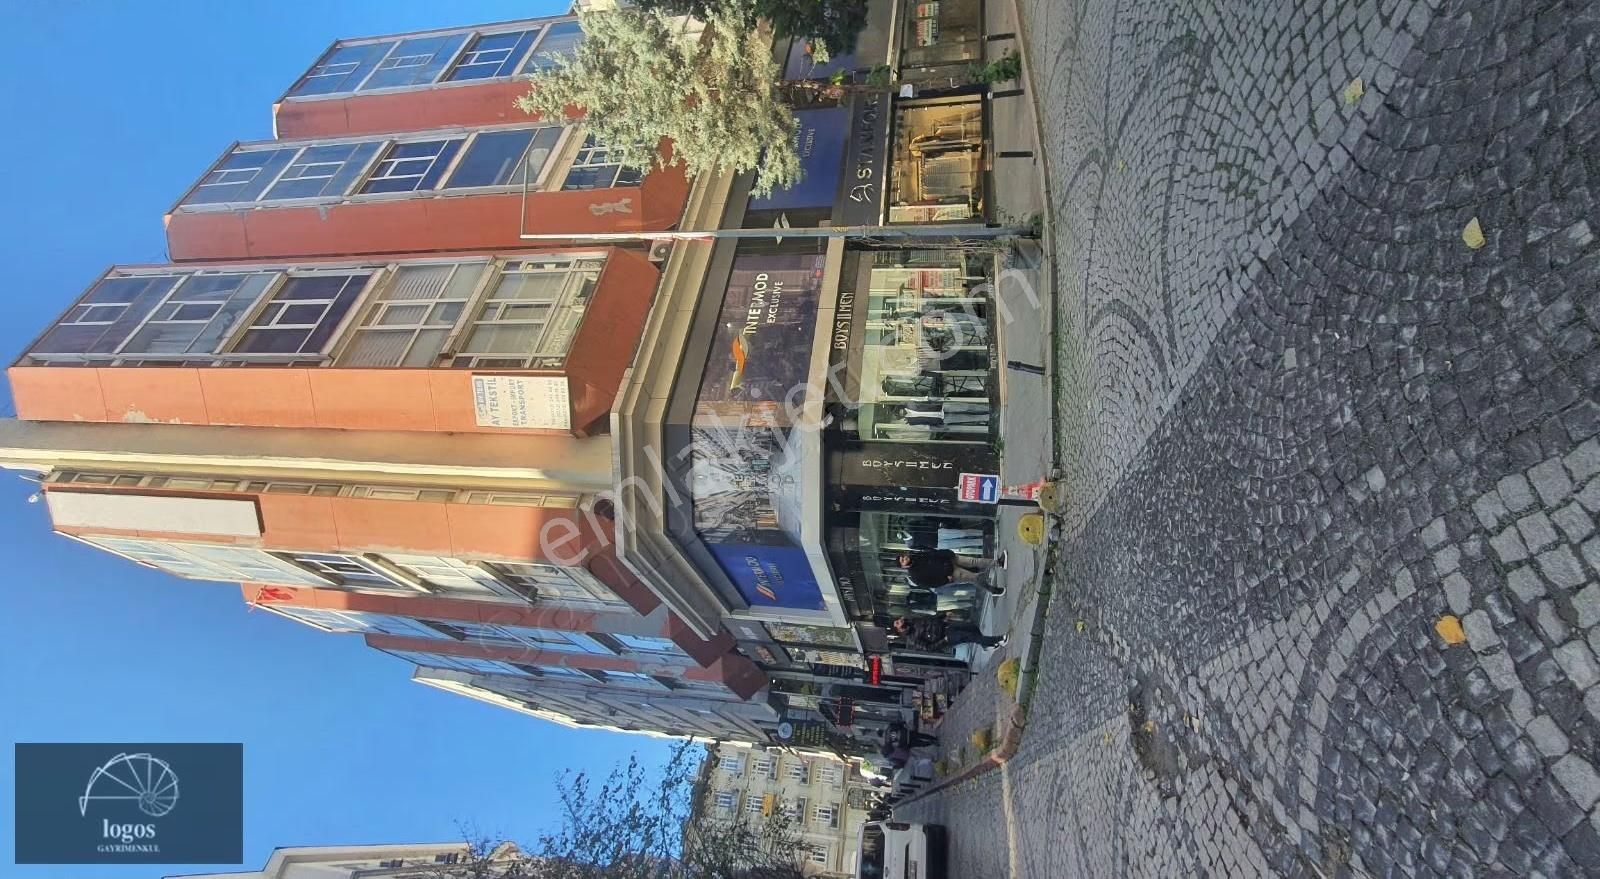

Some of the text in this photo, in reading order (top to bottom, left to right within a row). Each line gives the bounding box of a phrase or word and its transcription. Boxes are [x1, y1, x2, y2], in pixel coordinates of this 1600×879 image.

[742, 273, 769, 336] INTERMOD
[766, 281, 784, 324] EXCLUSIVE
[840, 292, 855, 313] MEN
[833, 320, 850, 350] BOYS
[516, 379, 527, 425] TRANSPORT
[491, 415, 501, 426] AY
[862, 459, 905, 468] BOYS
[965, 476, 977, 500] OTOPARK
